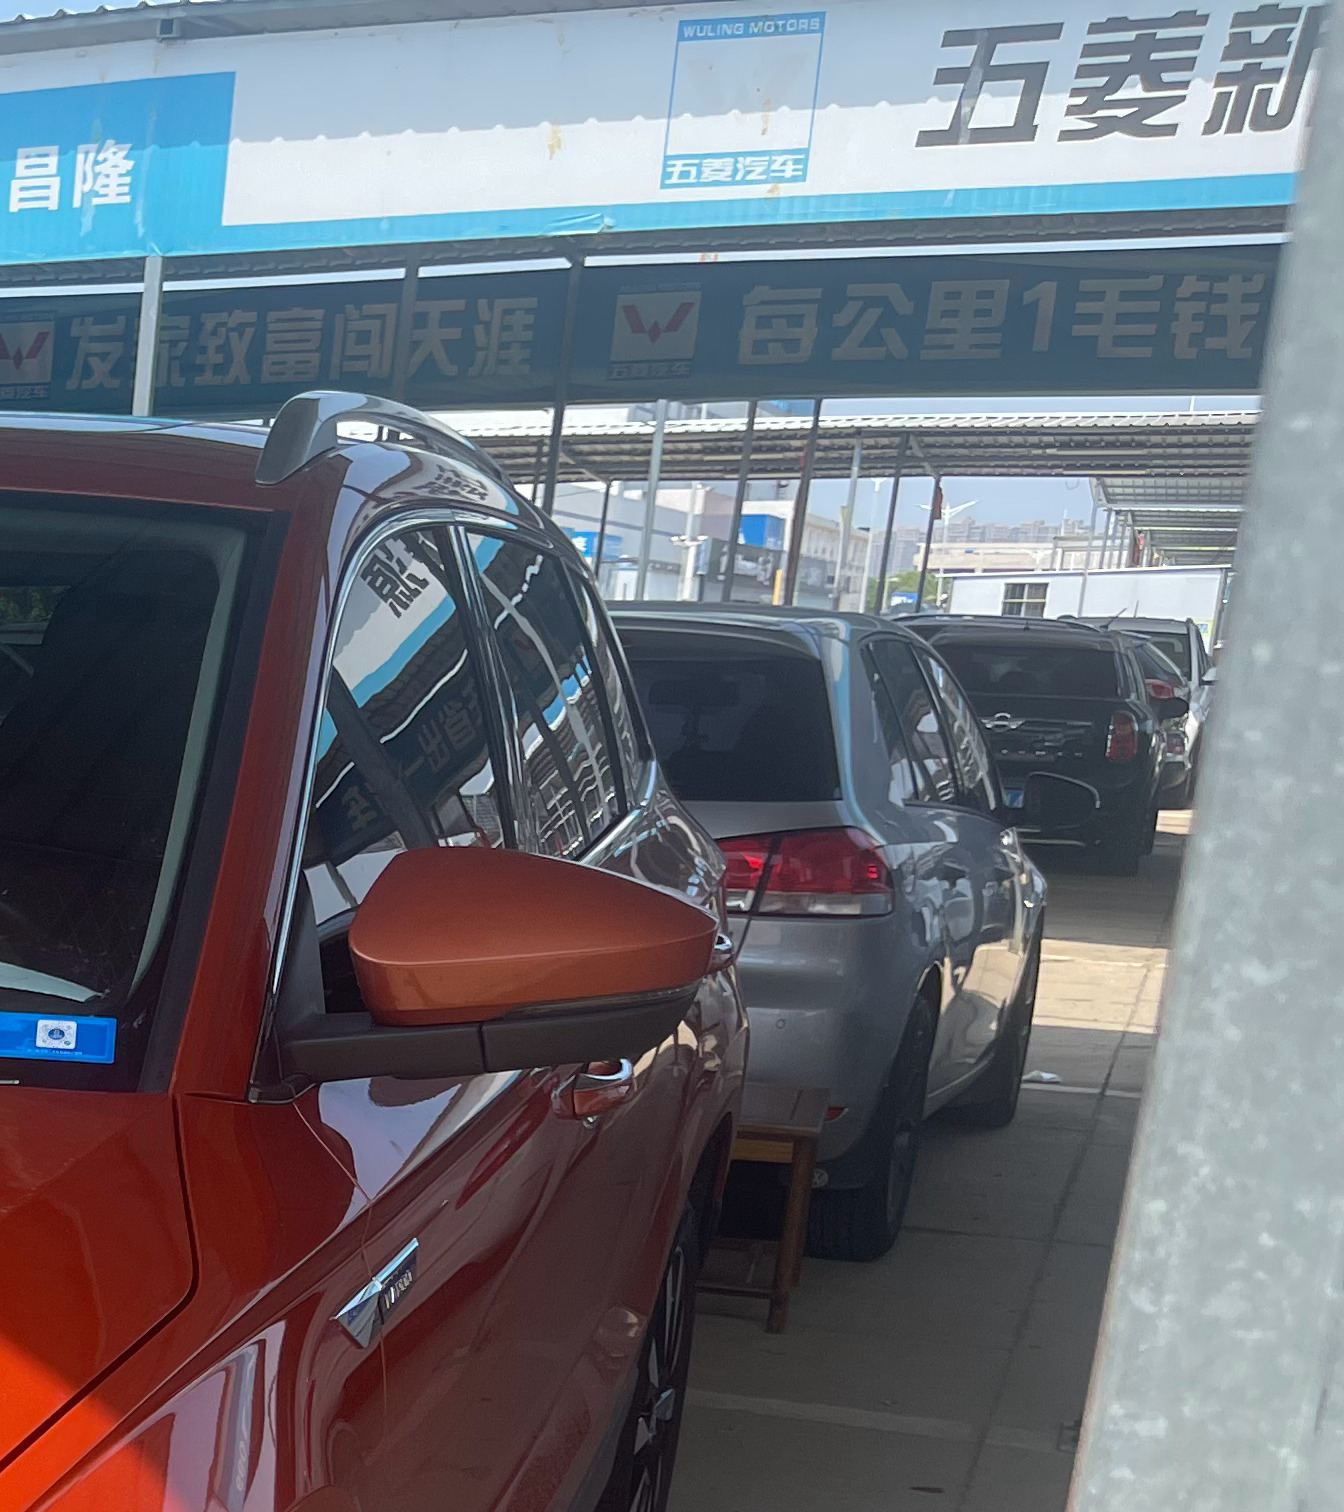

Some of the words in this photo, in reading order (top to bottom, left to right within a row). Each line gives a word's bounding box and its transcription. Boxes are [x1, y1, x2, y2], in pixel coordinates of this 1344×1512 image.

[683, 20, 744, 38] WULING
[749, 17, 820, 35] MOTORS
[665, 155, 805, 184] 五菱汽车
[69, 298, 538, 388] 发家致富闯天涯
[737, 272, 1267, 366] 每公里1毛钱
